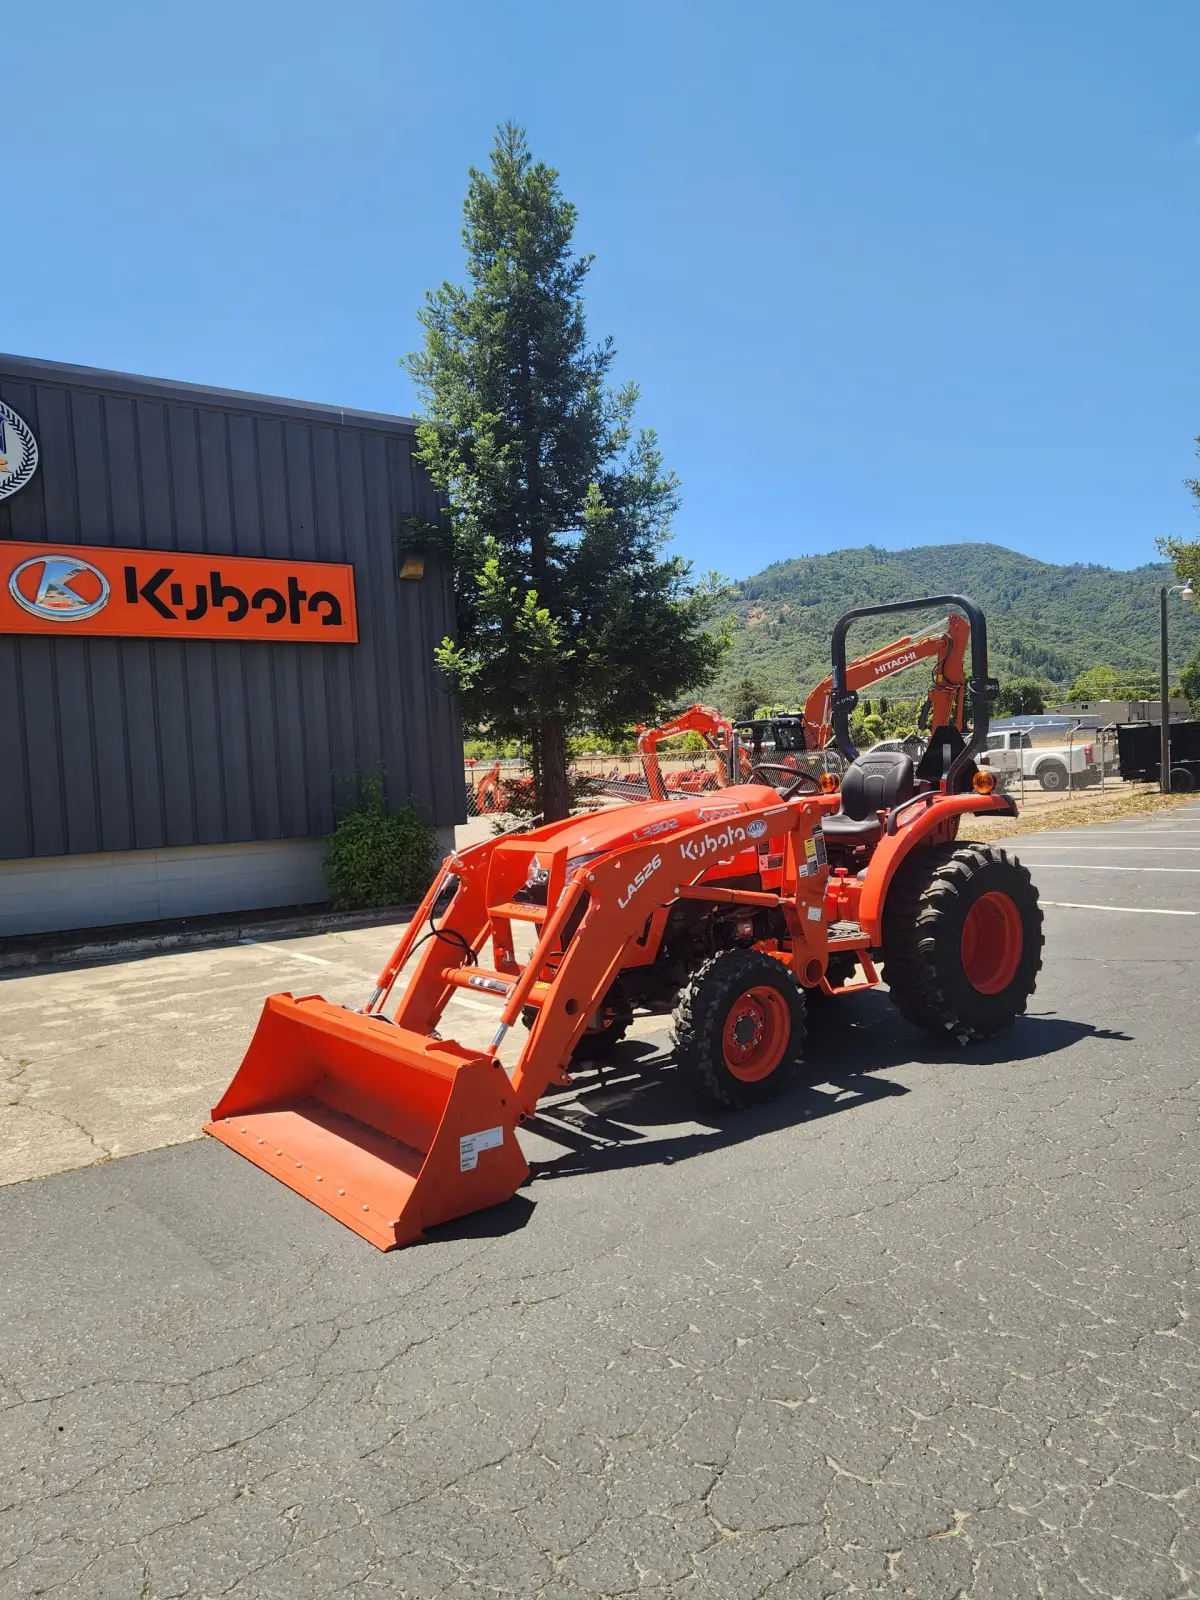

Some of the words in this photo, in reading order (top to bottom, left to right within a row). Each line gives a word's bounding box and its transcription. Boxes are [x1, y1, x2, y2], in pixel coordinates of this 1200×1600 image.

[124, 566, 343, 626] Kubota
[874, 651, 917, 675] HITACHI
[632, 818, 679, 841] L3302
[680, 825, 746, 861] Kubota
[617, 853, 662, 909] LA526
